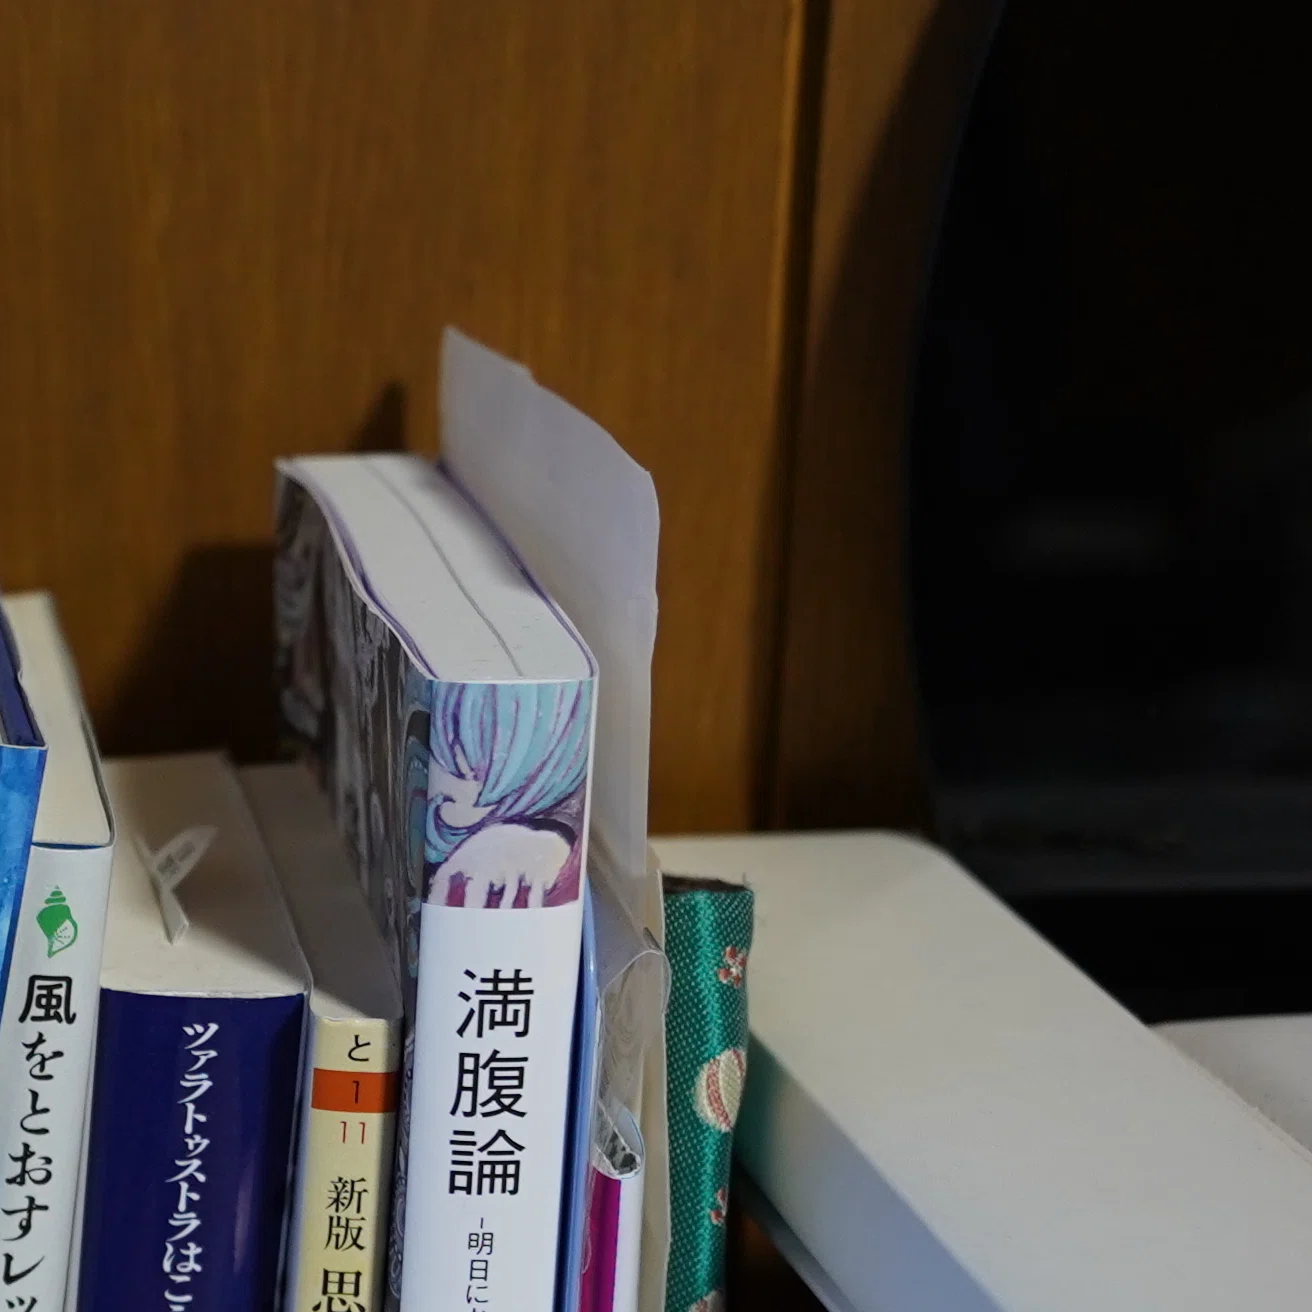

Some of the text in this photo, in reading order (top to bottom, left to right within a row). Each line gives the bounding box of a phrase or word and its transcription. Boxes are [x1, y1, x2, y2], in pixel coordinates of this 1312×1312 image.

[447, 967, 535, 1198] 満腹論
[324, 1175, 370, 1253] 新版
